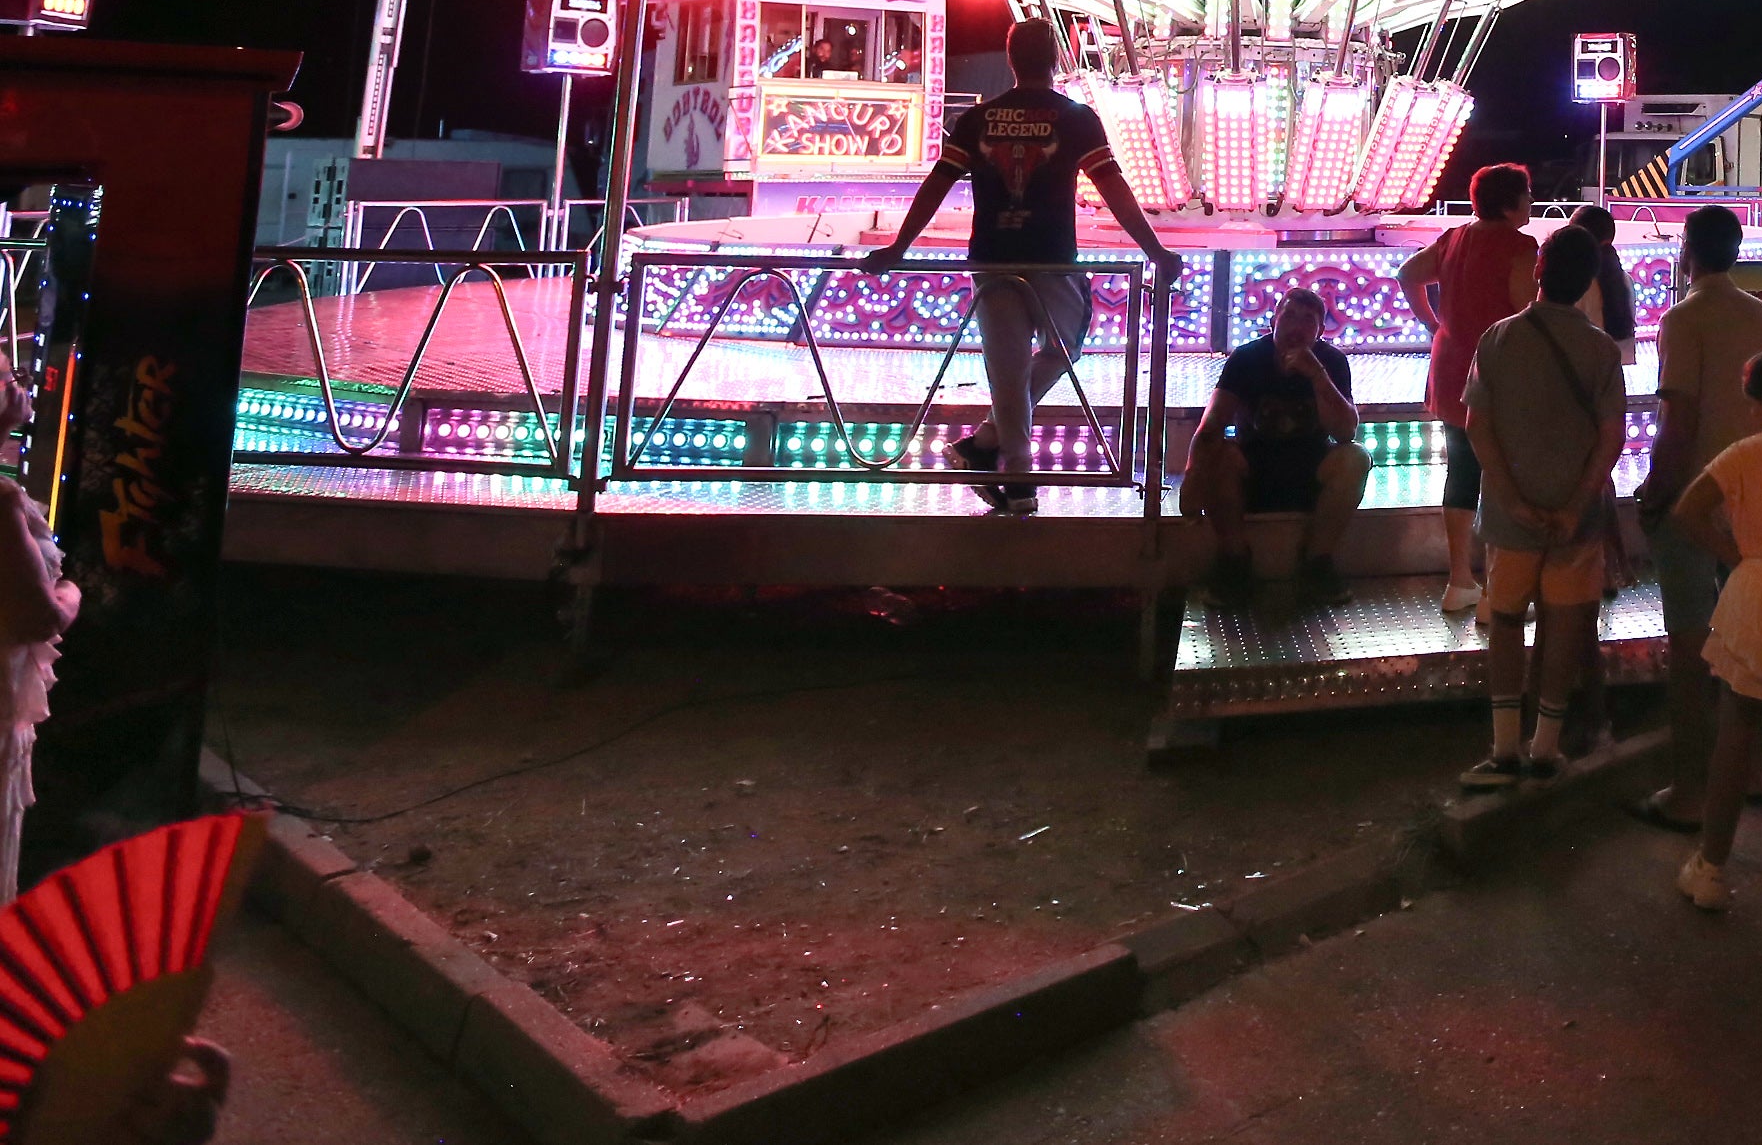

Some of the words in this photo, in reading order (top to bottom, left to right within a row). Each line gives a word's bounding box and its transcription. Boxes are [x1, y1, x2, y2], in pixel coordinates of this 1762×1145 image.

[766, 100, 903, 154] KANGURO
[986, 123, 1052, 137] LEGEND
[801, 133, 868, 156] SHOW
